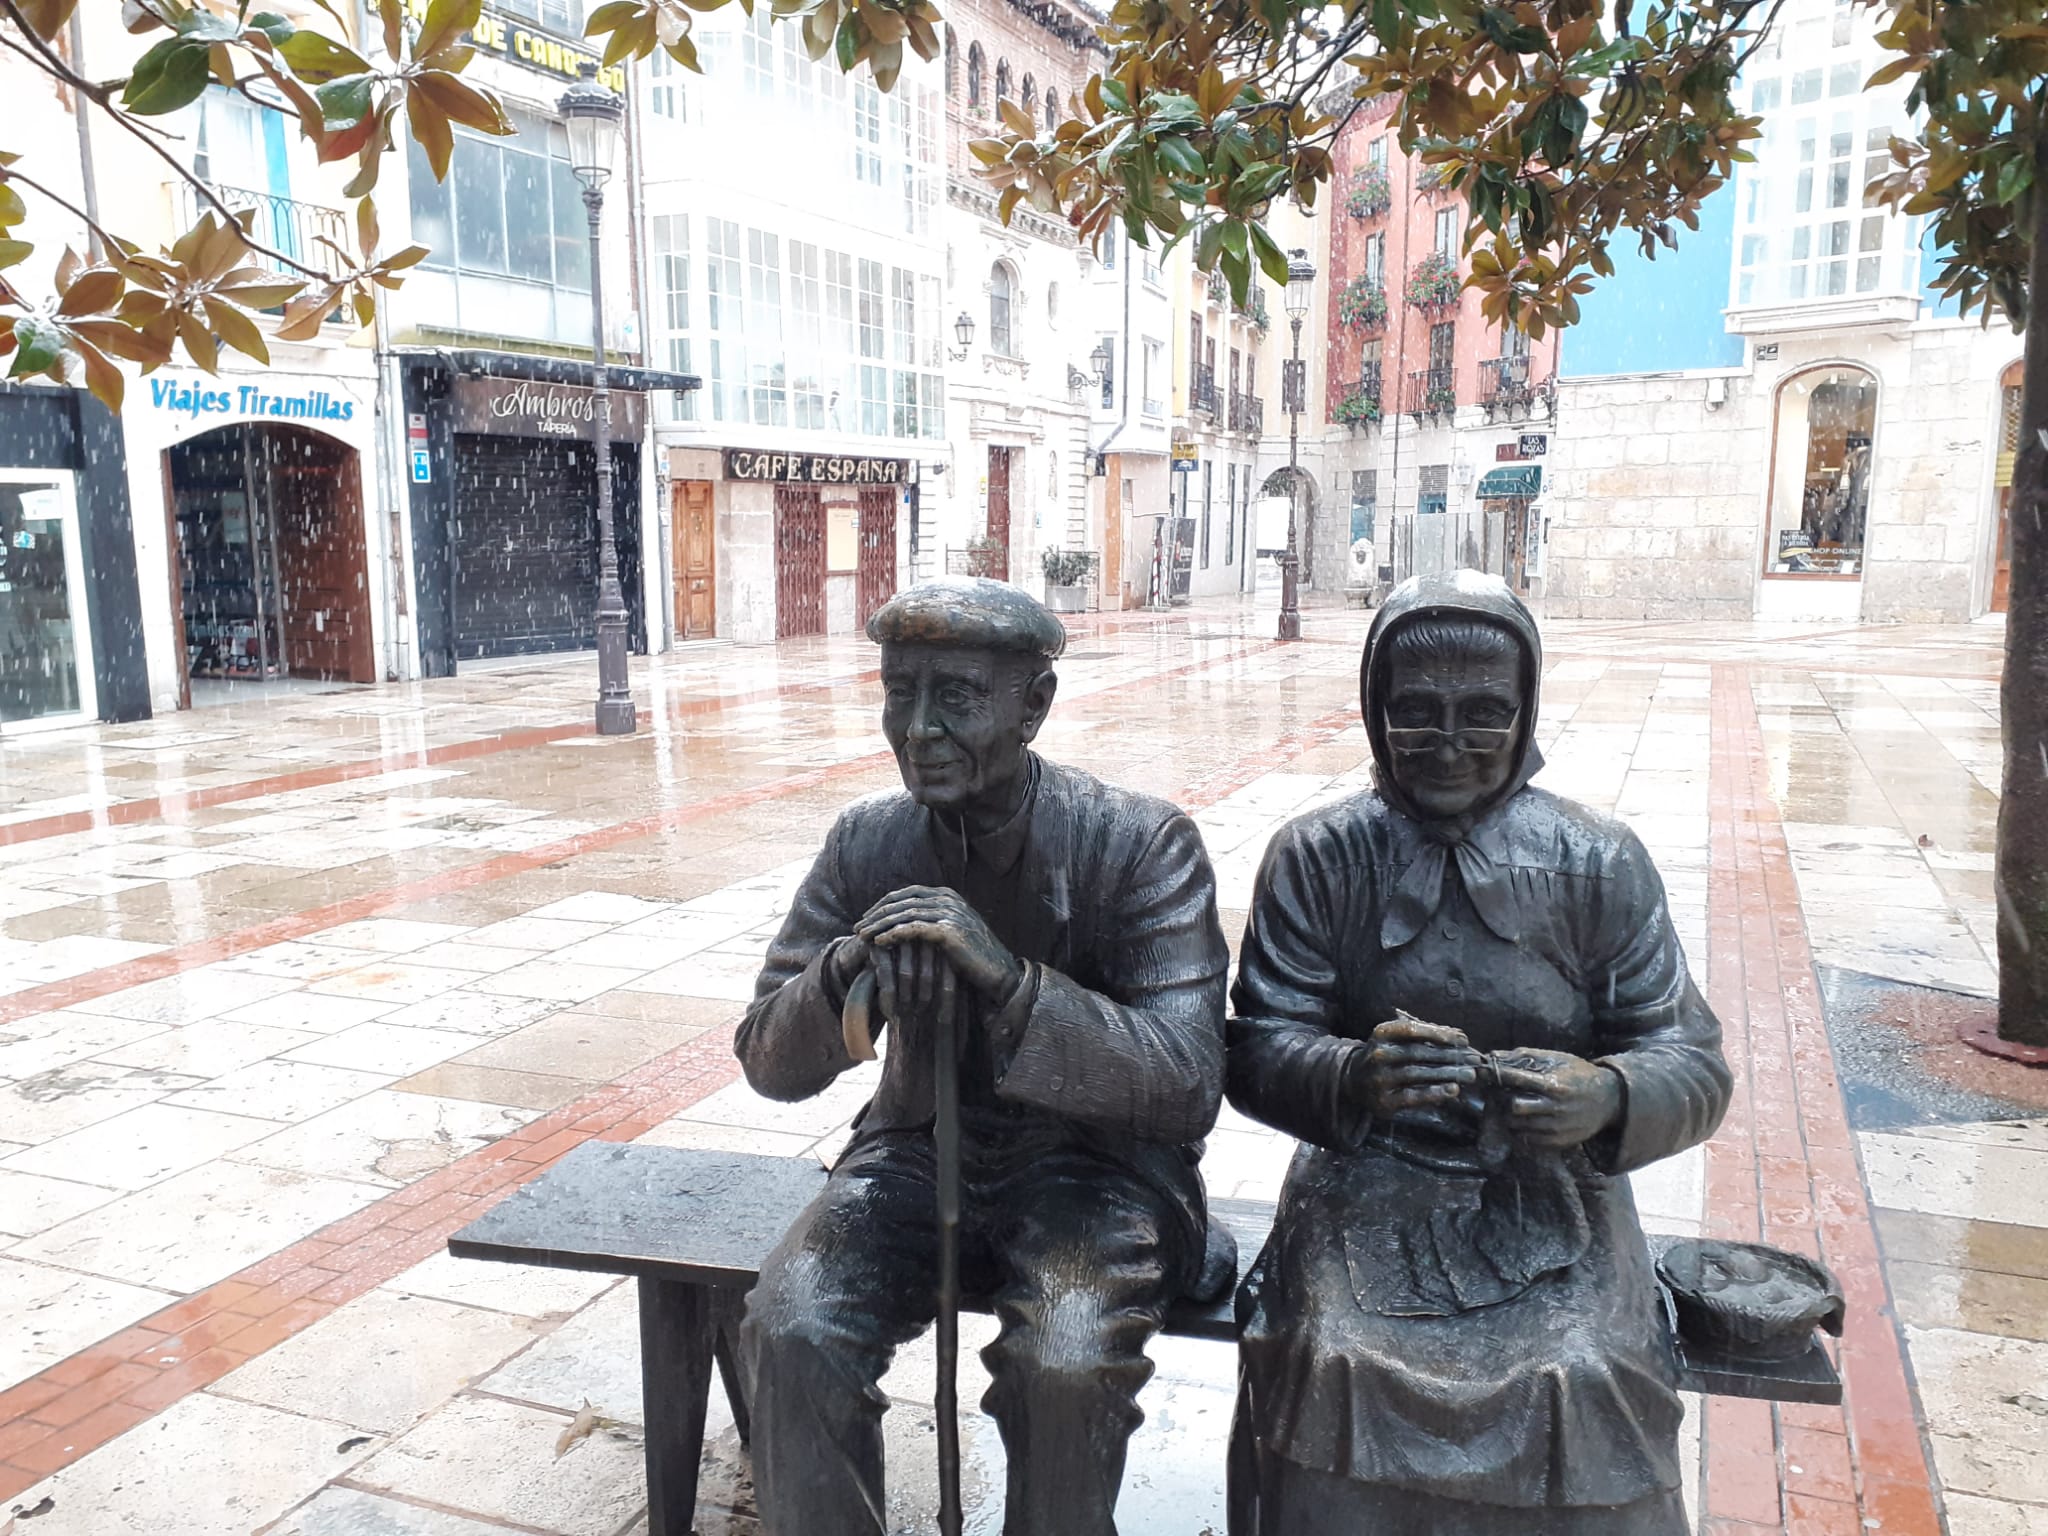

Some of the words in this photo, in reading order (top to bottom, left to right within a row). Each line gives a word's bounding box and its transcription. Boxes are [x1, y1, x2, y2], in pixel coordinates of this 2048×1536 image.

[472, 14, 508, 51] DE
[514, 30, 625, 93] CANOGO
[151, 378, 231, 420] Viajes
[237, 386, 353, 421] Tiramillas
[491, 382, 612, 425] Ambros
[735, 452, 802, 481] CAFE
